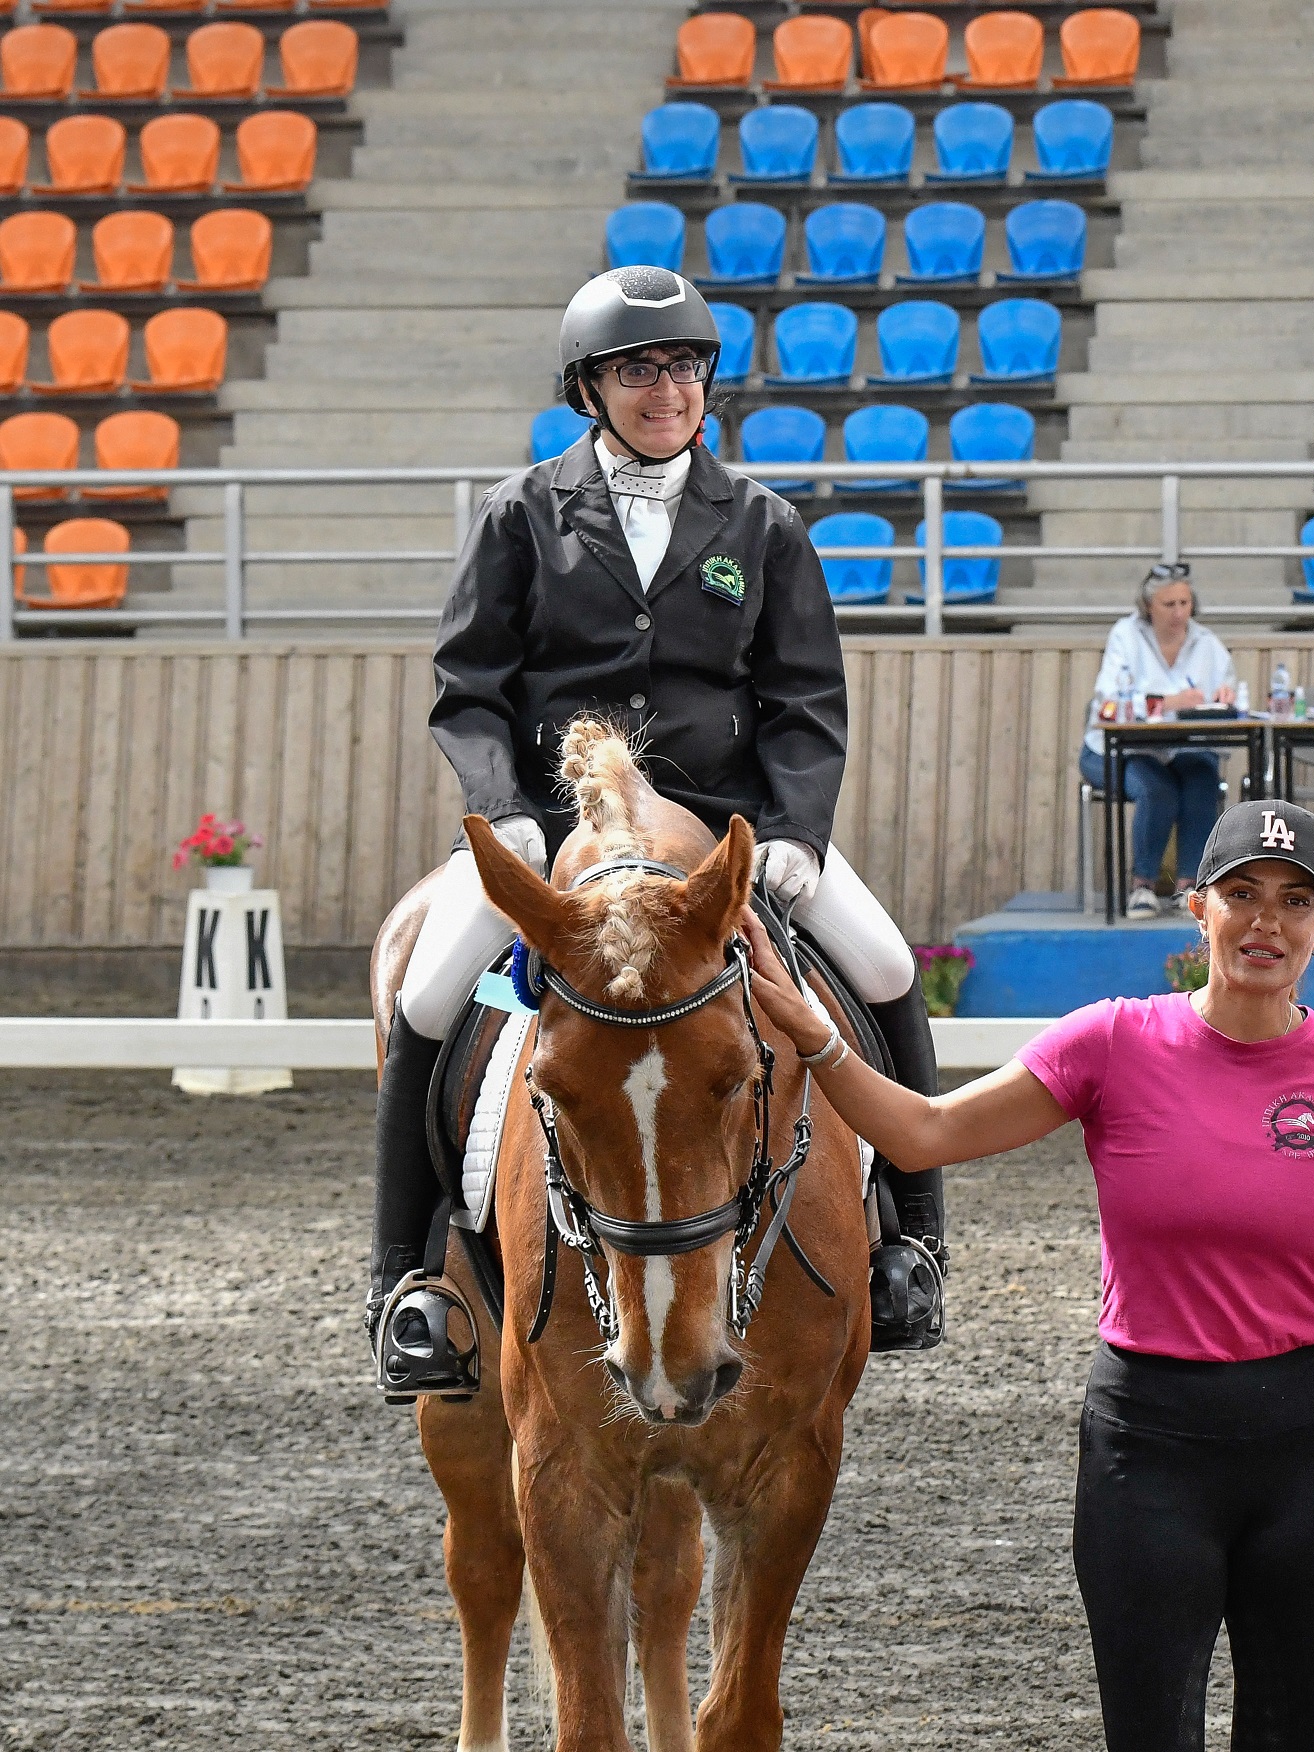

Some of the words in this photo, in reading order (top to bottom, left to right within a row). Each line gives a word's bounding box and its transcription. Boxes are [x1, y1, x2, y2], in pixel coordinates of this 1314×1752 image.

[1260, 811, 1295, 851] LA
[196, 909, 220, 989] K
[246, 909, 271, 990] K
